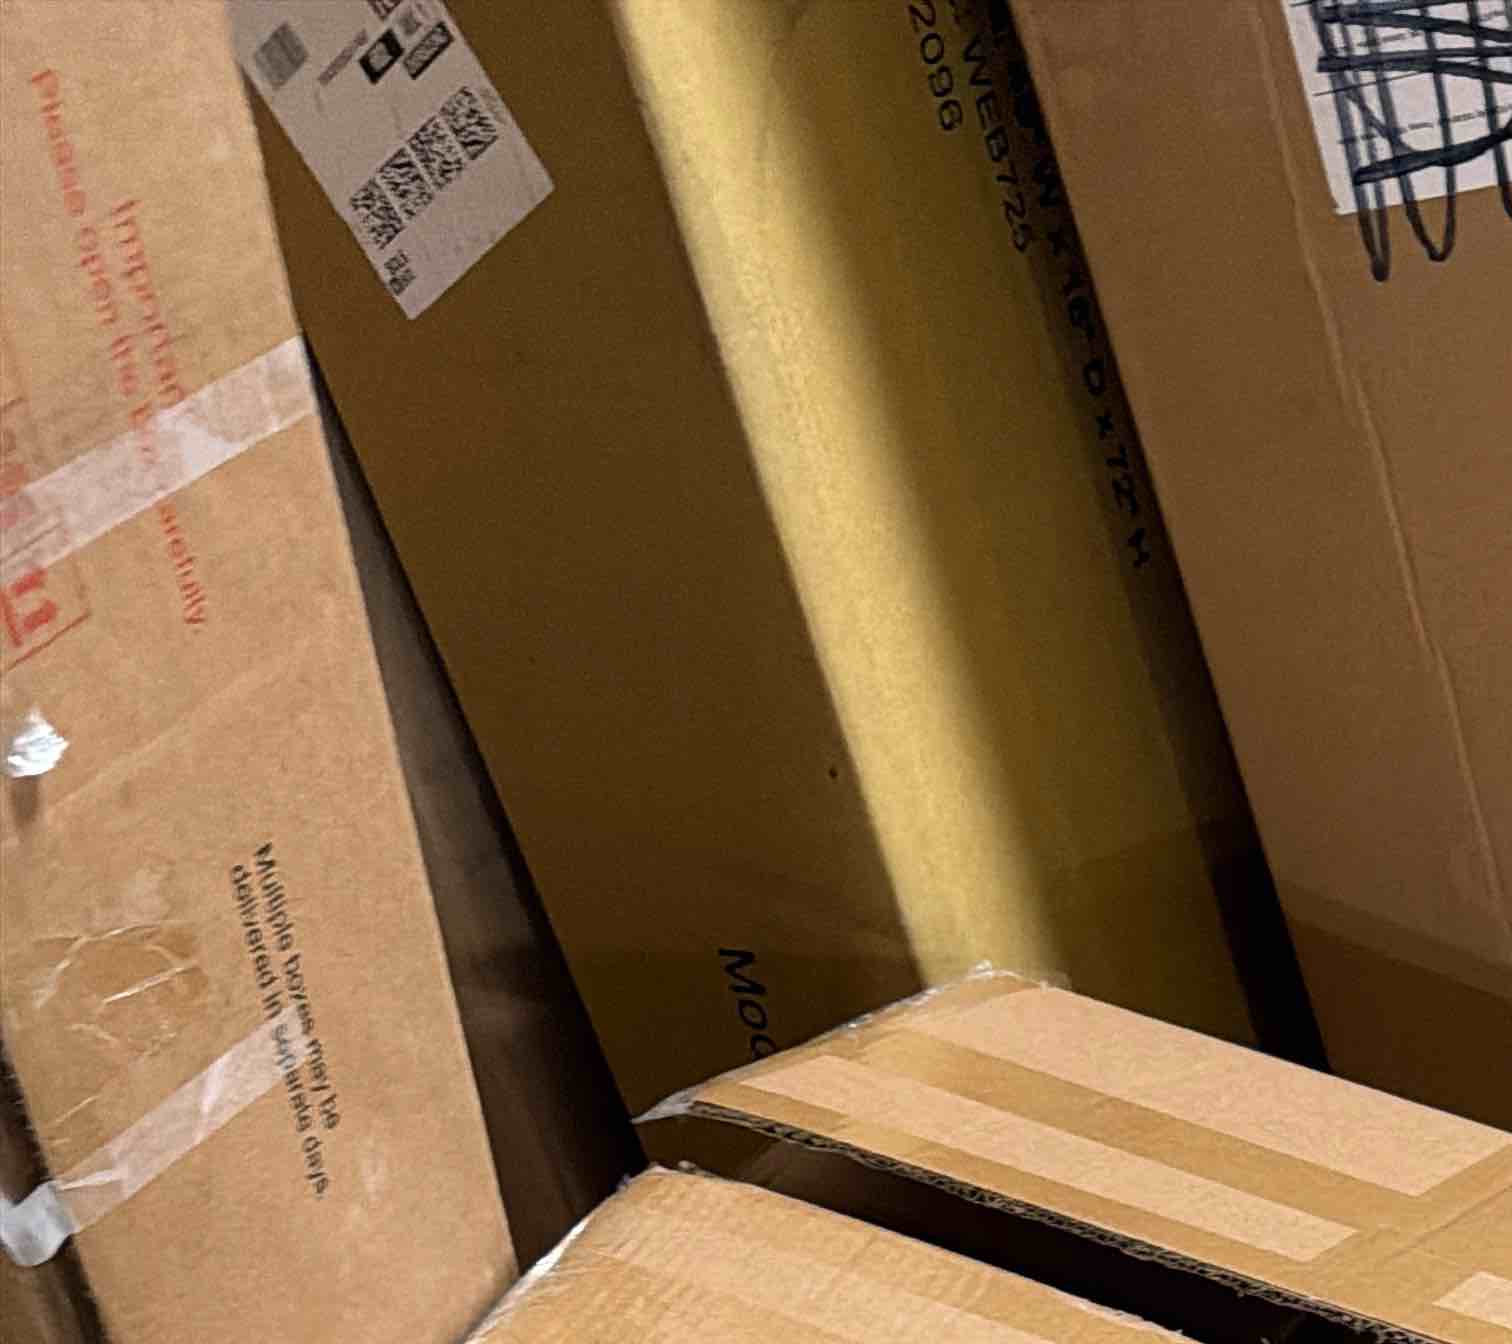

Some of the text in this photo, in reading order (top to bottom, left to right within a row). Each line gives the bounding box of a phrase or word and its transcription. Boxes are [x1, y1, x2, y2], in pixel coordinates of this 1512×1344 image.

[79, 225, 118, 326] open
[231, 864, 280, 990] delivered
[254, 842, 342, 1130] Multiple boxes may be
[261, 990, 283, 1020] in
[271, 1023, 314, 1134] separate
